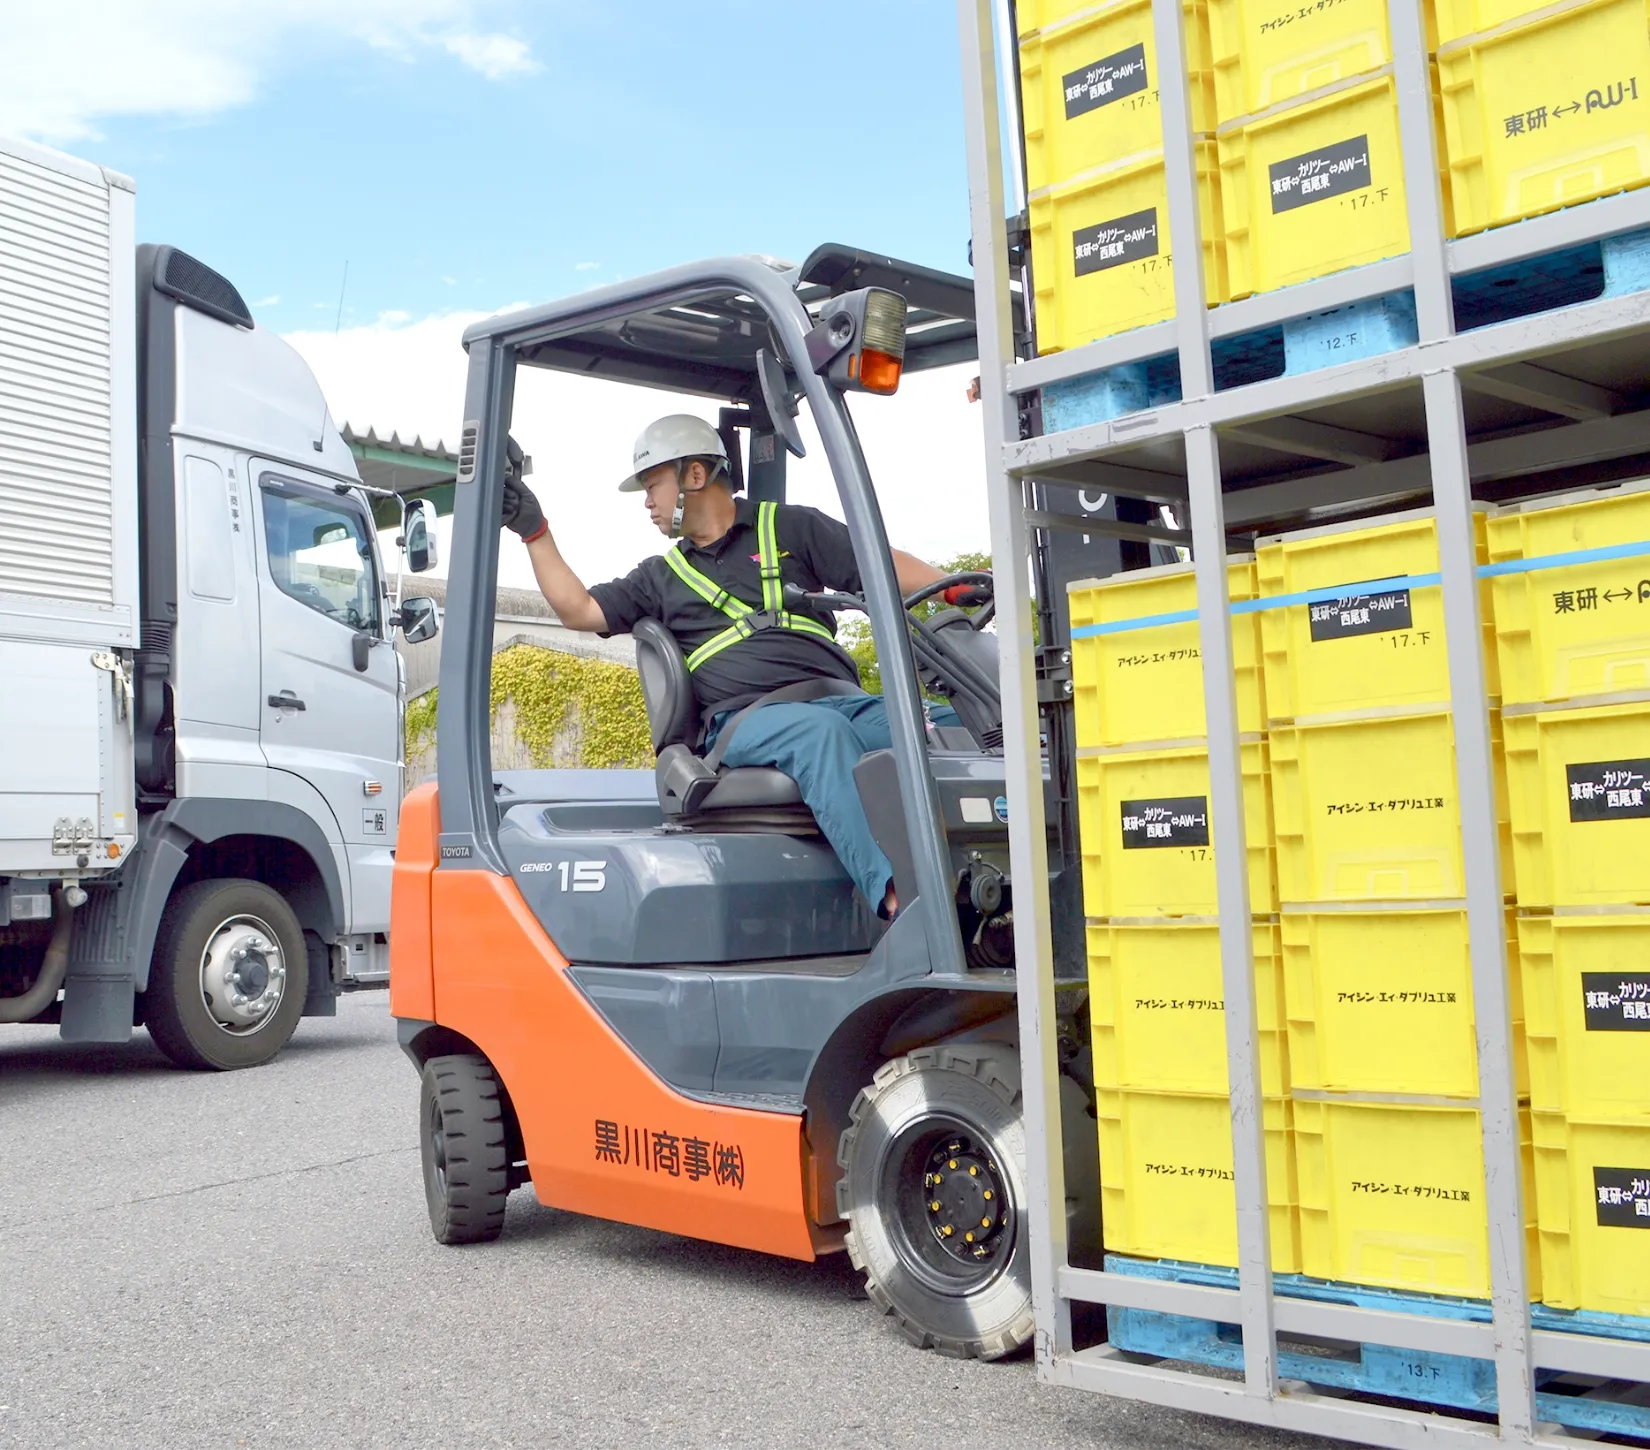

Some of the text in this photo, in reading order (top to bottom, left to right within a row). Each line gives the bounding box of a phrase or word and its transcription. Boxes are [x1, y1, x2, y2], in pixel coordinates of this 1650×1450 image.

[1065, 84, 1081, 102] 東研
[1503, 106, 1548, 139] 東研
[1272, 176, 1291, 195] 東研
[1301, 173, 1330, 194] 西尾東
[1075, 242, 1091, 259] 東研
[1553, 587, 1598, 614] 東研
[1311, 605, 1330, 622] 東研
[1340, 607, 1370, 626] 西尾東
[1570, 771, 1643, 800] 東研 カリツー
[1606, 788, 1643, 807] 西尾東
[1123, 816, 1138, 831] 東研
[443, 847, 470, 857] TOYOTA
[1181, 849, 1215, 861] '17.
[520, 861, 607, 892] GENEO 15
[1585, 982, 1650, 1009] 東研 カリツ
[1597, 1178, 1650, 1204] 東研 カリ
[1634, 1198, 1650, 1216] 西
